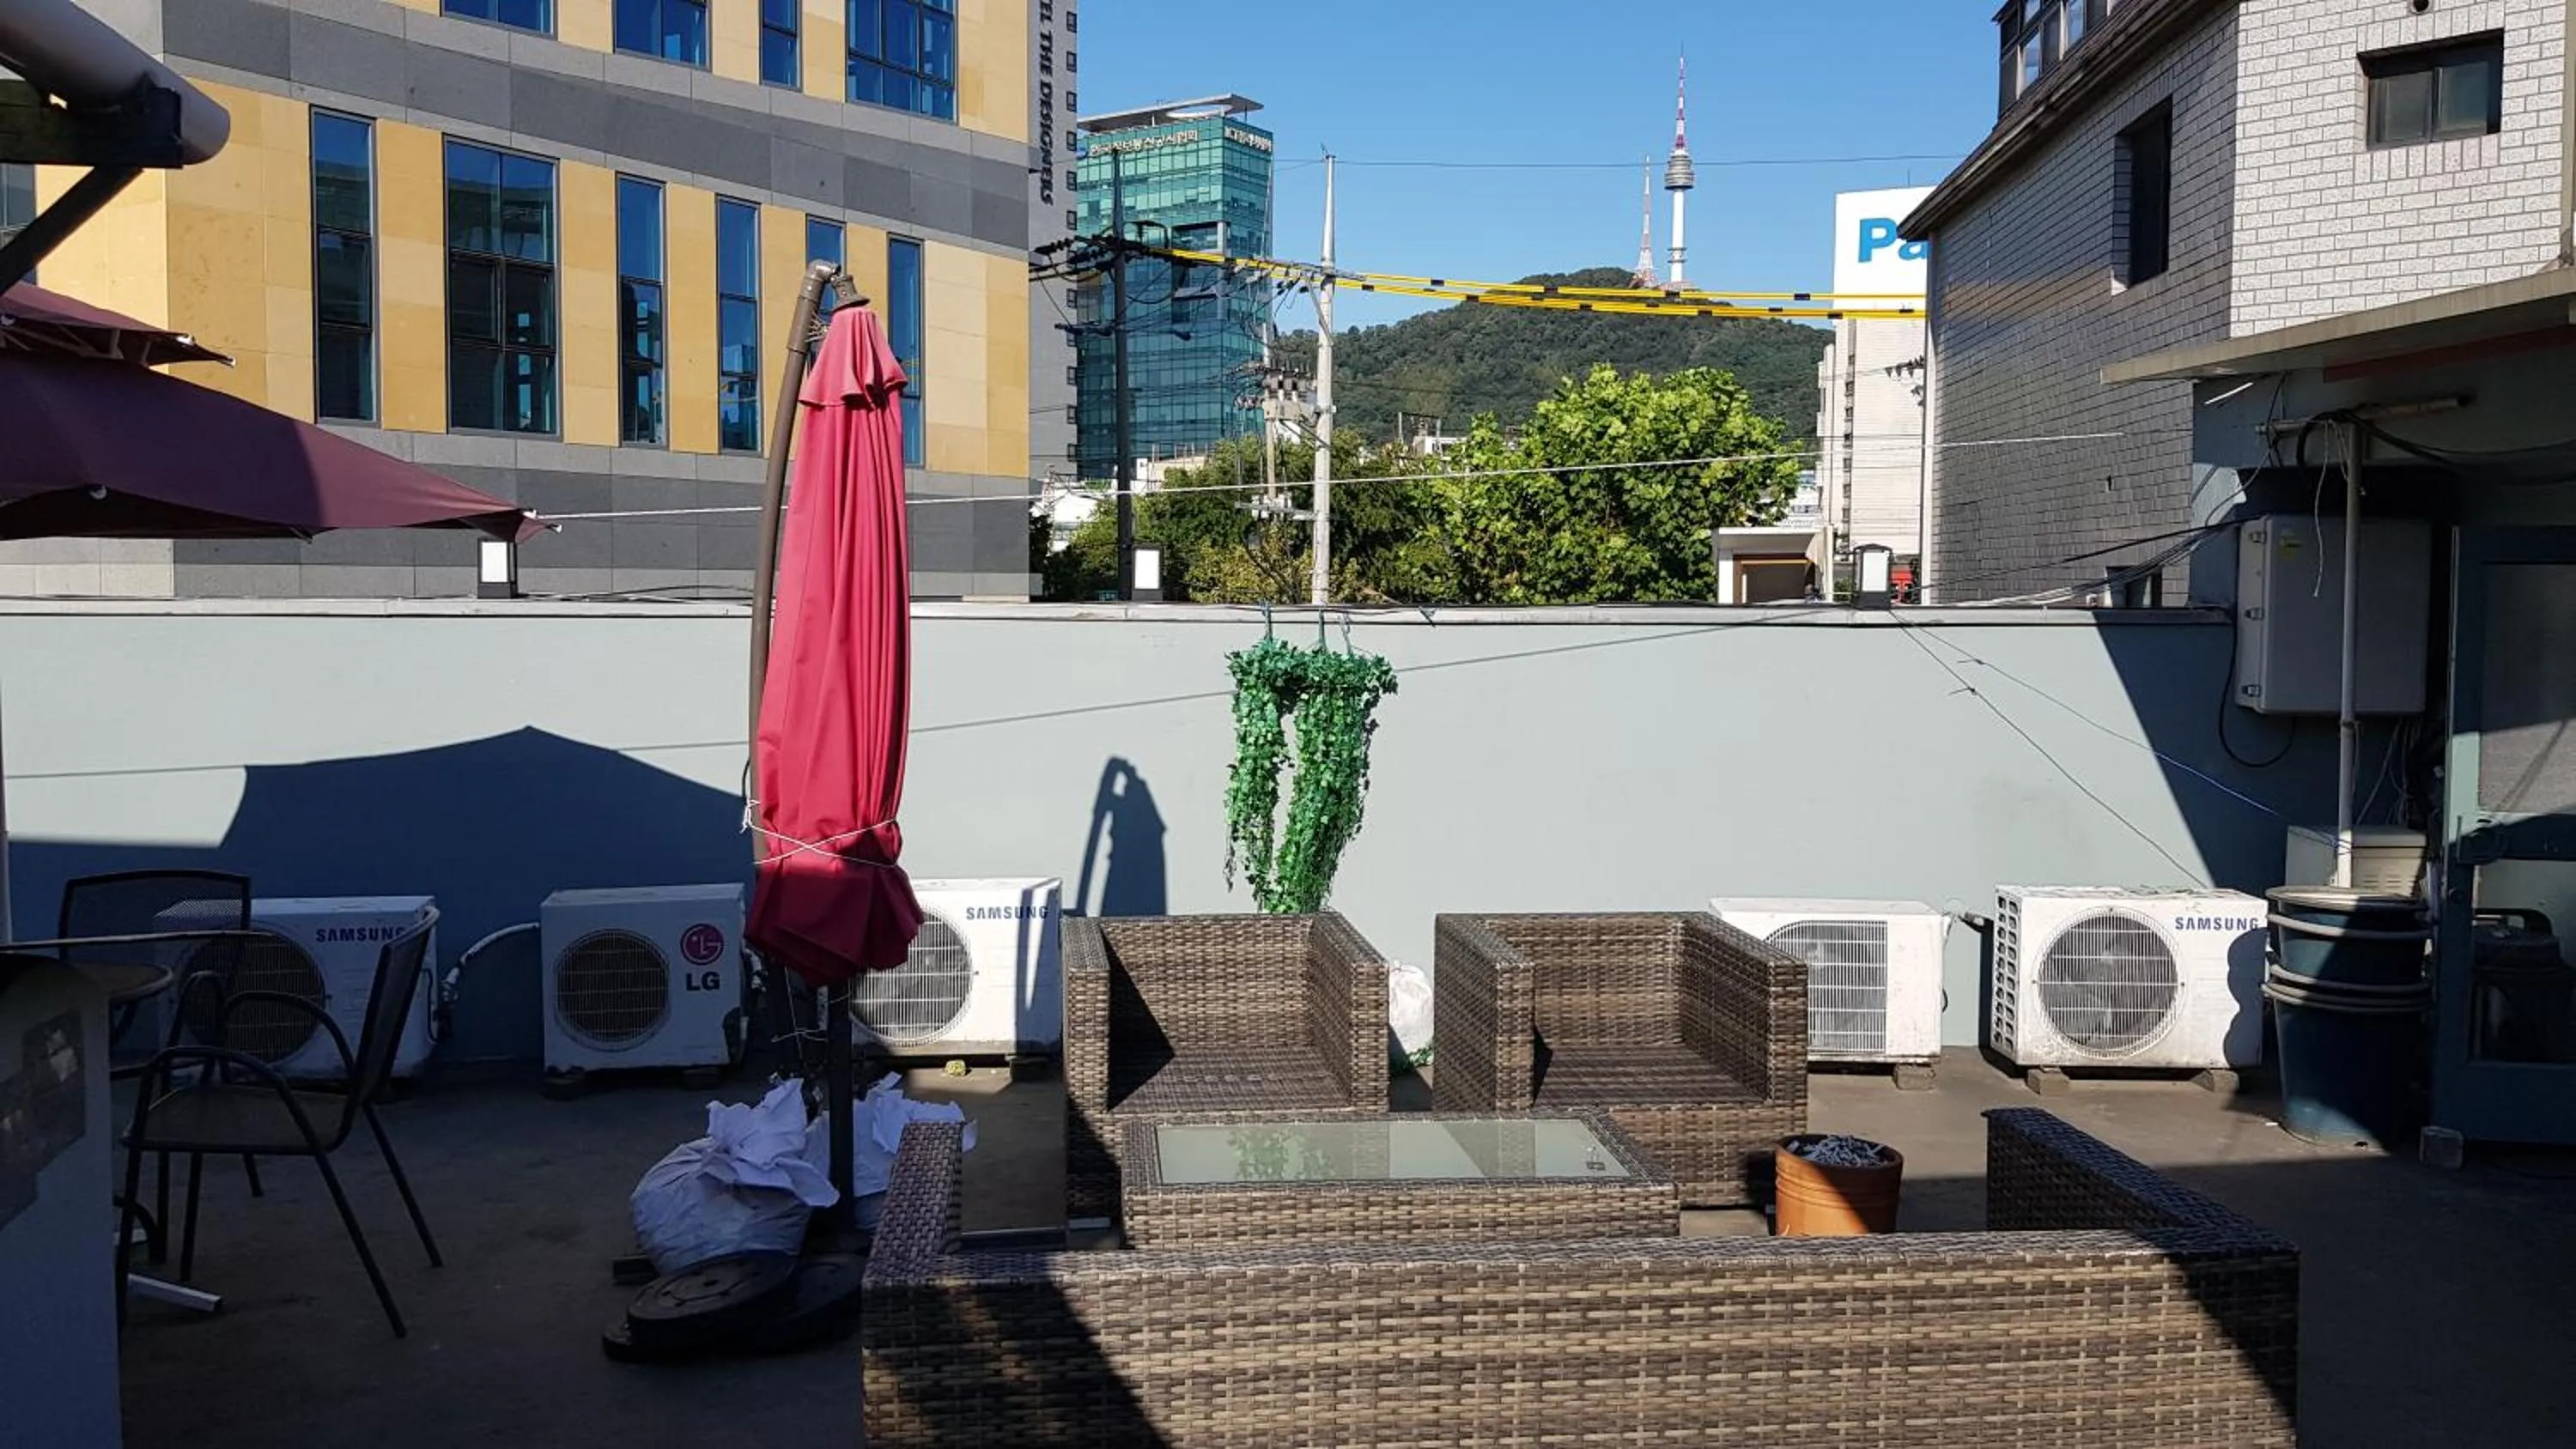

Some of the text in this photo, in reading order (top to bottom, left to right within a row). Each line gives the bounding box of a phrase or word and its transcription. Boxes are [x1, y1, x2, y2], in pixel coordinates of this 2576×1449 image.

[1040, 30, 1053, 77] THE
[1040, 80, 1054, 206] DESIGNERS
[966, 906, 1049, 920] SAMSUNG
[2175, 917, 2259, 931] SAMSUNG
[686, 971, 720, 991] LG
